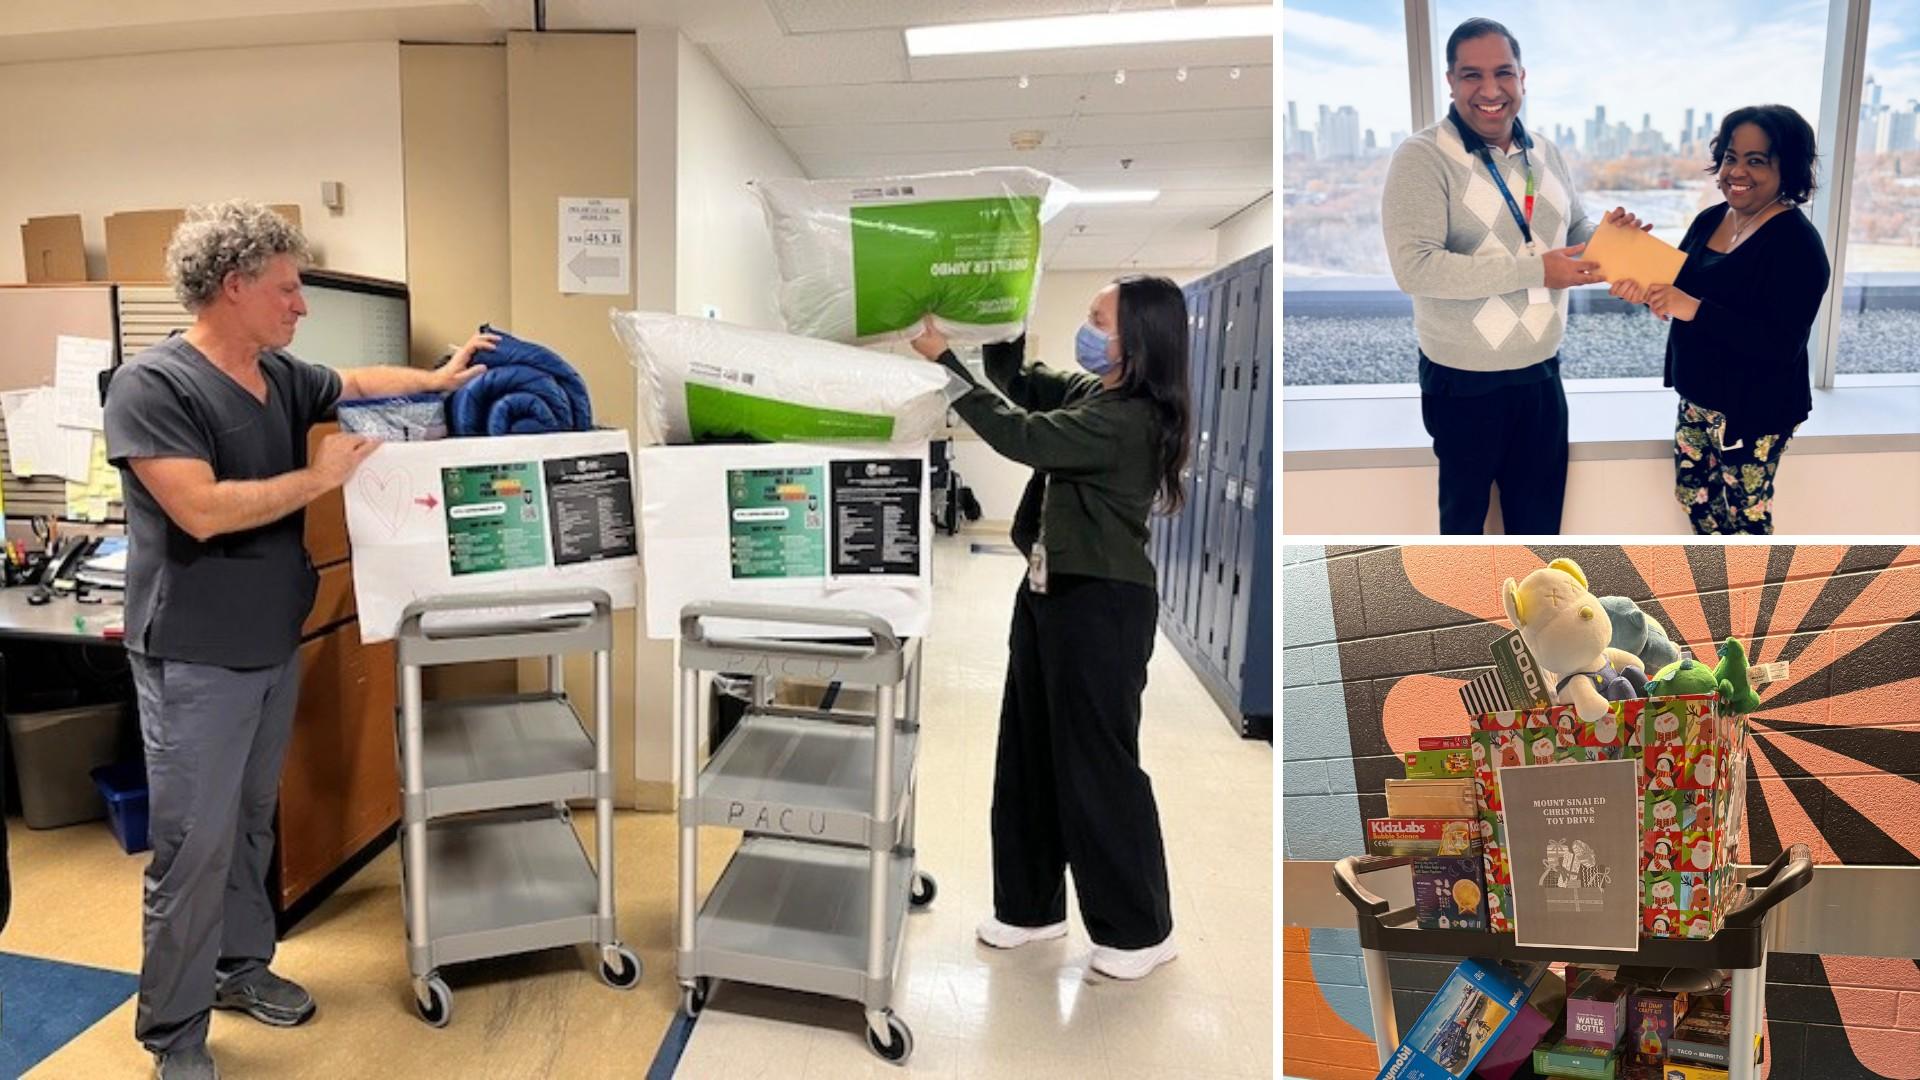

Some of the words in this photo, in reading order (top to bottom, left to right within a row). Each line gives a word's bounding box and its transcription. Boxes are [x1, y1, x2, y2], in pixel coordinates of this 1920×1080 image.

[1533, 799, 1565, 807] MOUNT
[1566, 797, 1592, 806] SINAI
[1593, 797, 1606, 805] ED
[1543, 807, 1595, 816] CHRISTMAS
[727, 801, 826, 836] PACU
[1545, 817, 1565, 825] TOY
[1566, 816, 1595, 825] DRIVE
[1371, 821, 1426, 833] KidzLabs
[1576, 1015, 1604, 1026] WATER
[1576, 1023, 1605, 1034] BOTTLE
[1677, 1048, 1692, 1056] TACO
[1698, 1051, 1724, 1061] BURRITO
